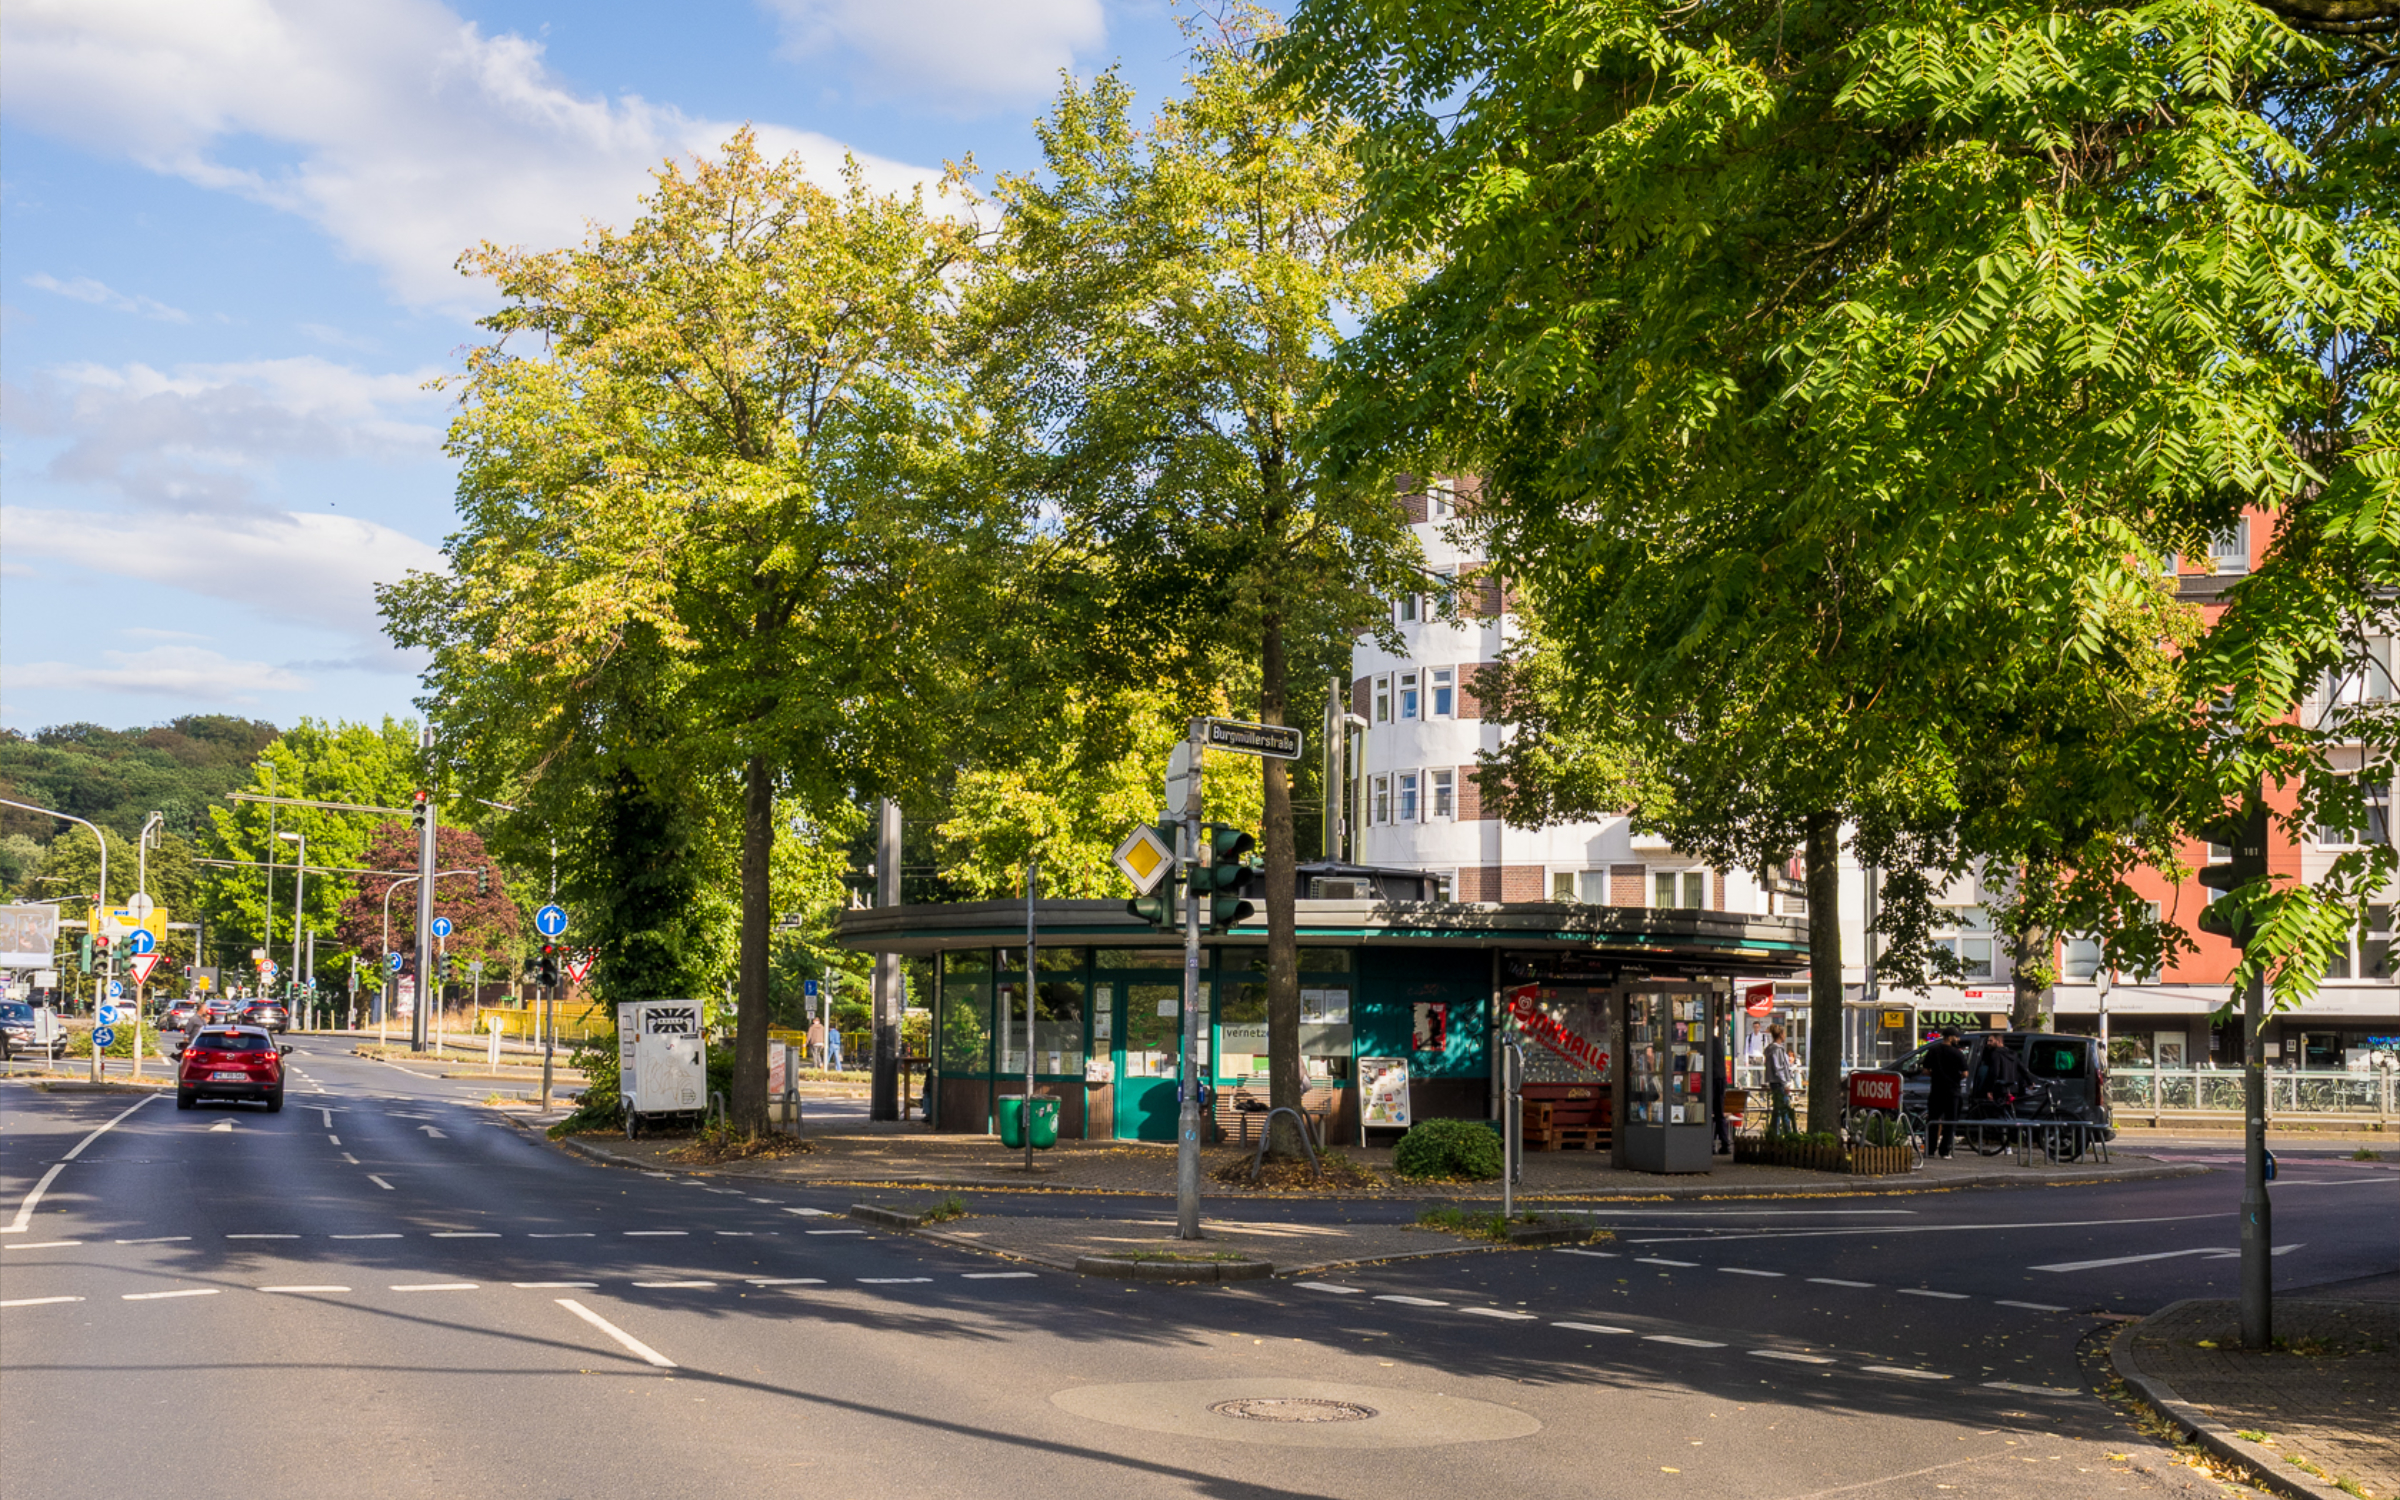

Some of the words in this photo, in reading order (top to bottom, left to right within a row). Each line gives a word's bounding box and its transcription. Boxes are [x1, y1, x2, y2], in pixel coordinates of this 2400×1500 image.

[1213, 725, 1294, 751] Burgmüllerstraße
[1226, 1027, 1269, 1038] vernetz
[1857, 1080, 1893, 1099] KIOSK
